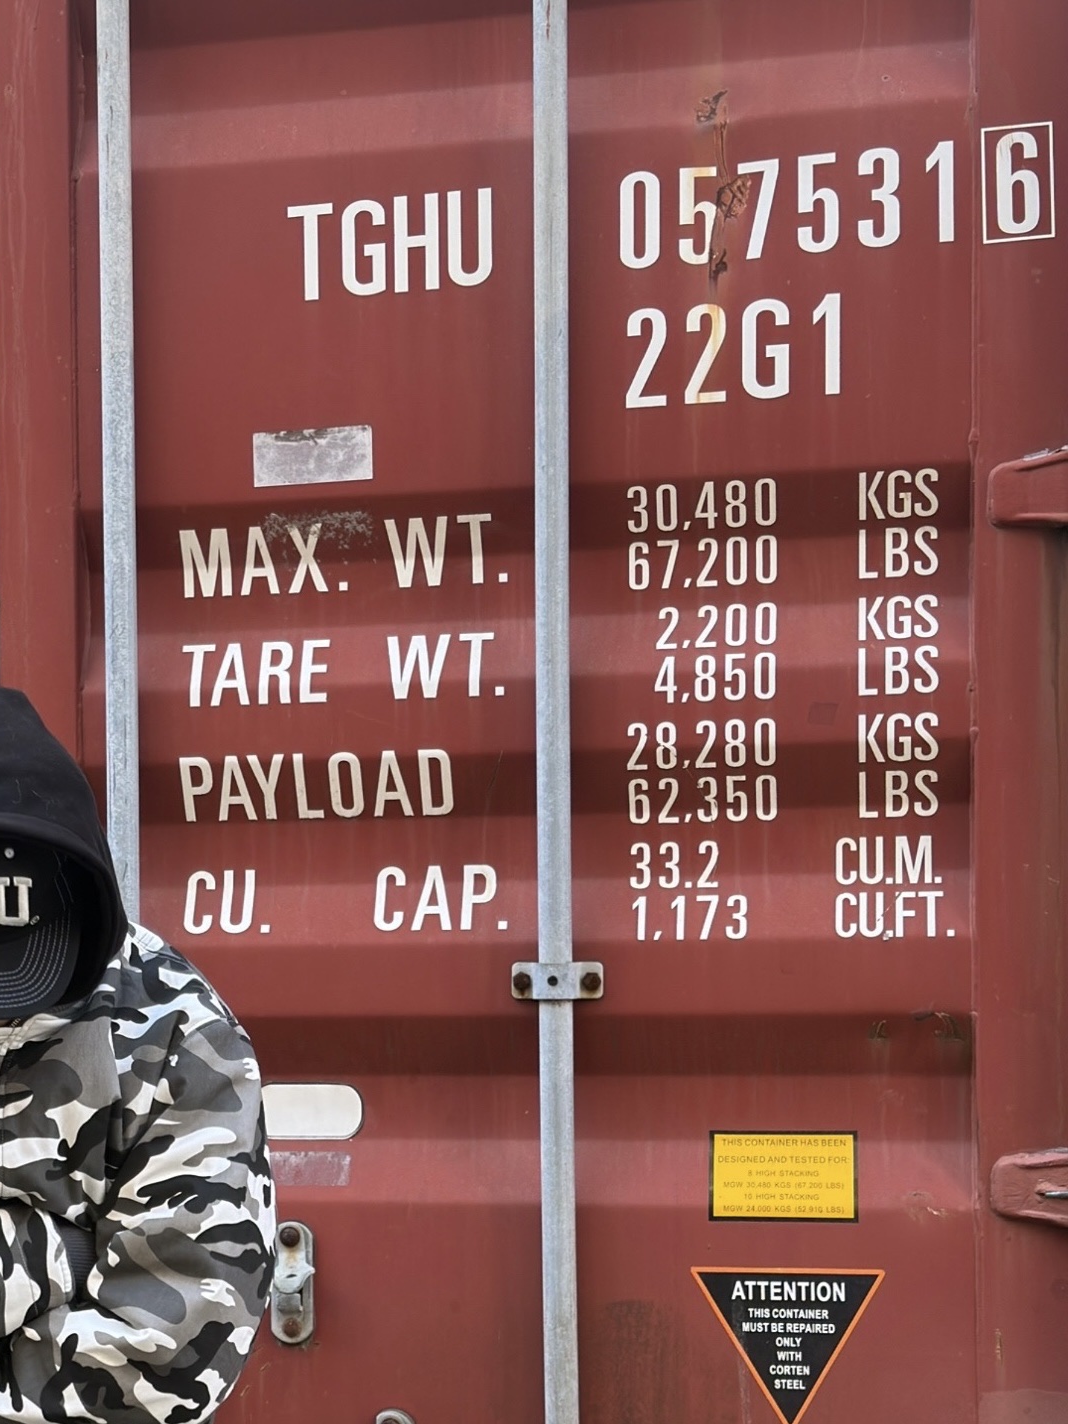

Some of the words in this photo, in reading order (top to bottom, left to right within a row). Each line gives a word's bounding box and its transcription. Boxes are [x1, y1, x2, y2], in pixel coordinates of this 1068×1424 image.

[287, 187, 493, 301] TGHU
[620, 139, 954, 269] 057531
[625, 292, 841, 409] 22G1
[627, 477, 778, 534] 30,480
[858, 467, 939, 521] KGS
[179, 525, 348, 598] MAX.
[384, 513, 508, 588] WT.
[628, 534, 778, 591] 67,200
[858, 526, 939, 580] LBS
[655, 602, 778, 650] 2,200
[858, 594, 939, 641] KGS
[181, 637, 331, 707] TARE
[386, 628, 505, 700] WT.
[654, 652, 777, 704] 4,850
[858, 645, 939, 697] LBS
[626, 717, 777, 771] 28,280
[858, 712, 939, 763] KGS
[179, 748, 454, 822] PAYLOAD
[628, 774, 778, 824] 62,350
[858, 770, 939, 819] LBS
[630, 840, 719, 889] 33.2
[835, 835, 943, 885] CU.M.
[183, 869, 271, 935] CU.
[373, 864, 508, 932] CAP.
[632, 894, 748, 941] 1,173
[717, 1155, 766, 1164] DESIGNED
[767, 1155, 788, 1164] AND
[789, 1155, 827, 1164] TESTED
[722, 1139, 743, 1147] THIS
[744, 1138, 799, 1147] CONTAINER
[800, 1138, 820, 1147] HAS
[821, 1138, 847, 1147] BEEN
[755, 1169, 776, 1177] HIGH
[779, 1170, 820, 1178] STACKING
[774, 1181, 792, 1189] KGS
[779, 1193, 820, 1201] STACKING
[723, 1204, 743, 1213] MGW
[774, 1205, 792, 1213] KGS
[732, 1281, 846, 1302] ATTENTION
[748, 1308, 770, 1318] THIS
[772, 1308, 829, 1319] CONTAINER
[742, 1322, 770, 1333] MUST
[771, 1323, 785, 1333] BE
[786, 1323, 836, 1334] REPAIRED
[775, 1337, 802, 1347] ONLY
[769, 1365, 810, 1375] CORTEN
[777, 1351, 802, 1361] WITH
[774, 1379, 806, 1390] STEEL
